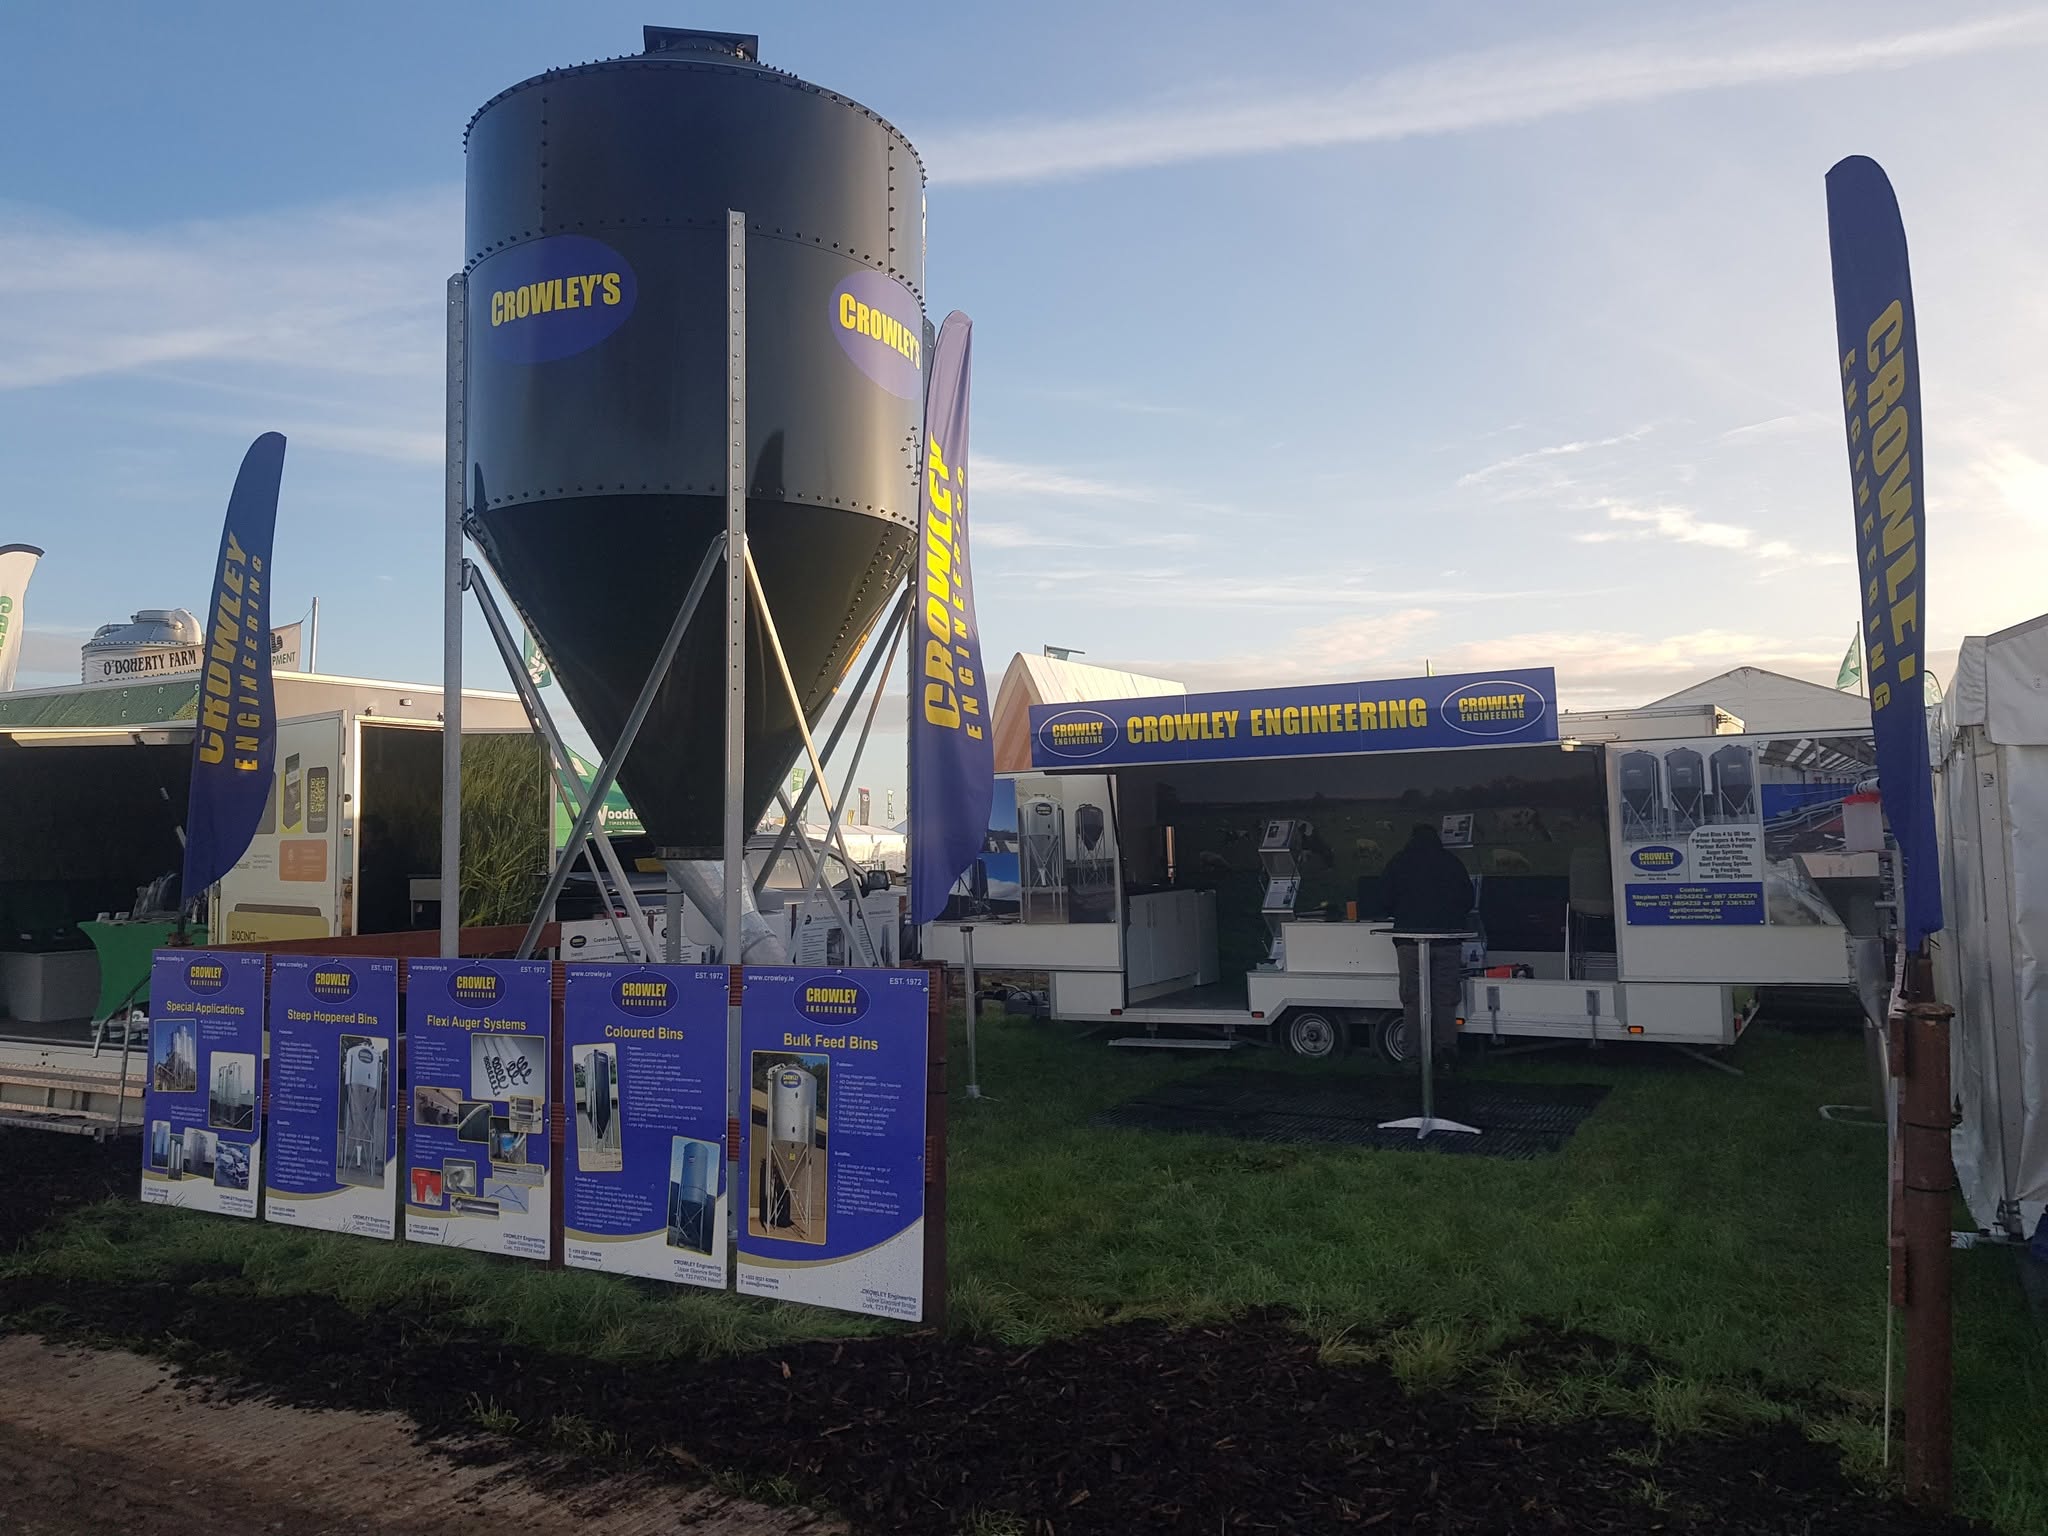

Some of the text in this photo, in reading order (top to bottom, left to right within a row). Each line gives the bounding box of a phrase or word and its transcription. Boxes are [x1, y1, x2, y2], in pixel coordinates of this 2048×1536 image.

[491, 272, 621, 327] CROWLEY'S
[839, 293, 921, 371] CROWLEY'S
[1843, 348, 1891, 712] ENGINEERING
[923, 431, 961, 730] CROWLEY
[951, 466, 983, 740] ENGINEERING
[200, 531, 248, 765] CROWLEY
[103, 654, 165, 676] O'DOHERTY
[169, 649, 197, 668] FARM
[234, 554, 264, 771] ENGINEERING
[272, 651, 296, 666] PMENT
[1458, 694, 1526, 713] CROWLEY
[1126, 698, 1428, 744] CROWLEY ENGINEERING
[1461, 709, 1525, 722] ENGINEERING
[1052, 722, 1104, 738] CROWLEY
[1054, 735, 1103, 745] ENGINEERING
[1639, 852, 1674, 860] CROWLEY
[190, 966, 222, 978] CROWLEY
[315, 972, 350, 986] CROWLEY
[570, 970, 612, 978] www.crowley.ie
[748, 974, 794, 982] www.crowley.ie
[456, 976, 496, 990] CROWLEY
[889, 977, 922, 986] EST. 1972
[622, 982, 667, 997] CROWLEY
[806, 988, 857, 1004] CROWLEY
[166, 1000, 244, 1015] Special Applications
[806, 1005, 857, 1014] ENGINEERING
[288, 1009, 378, 1024] Steep Hoppered Bins
[427, 1015, 526, 1031] Flexi Auger Systems
[605, 1025, 684, 1040] Coloured Bins
[784, 1033, 878, 1050] Bulk Feed Bins
